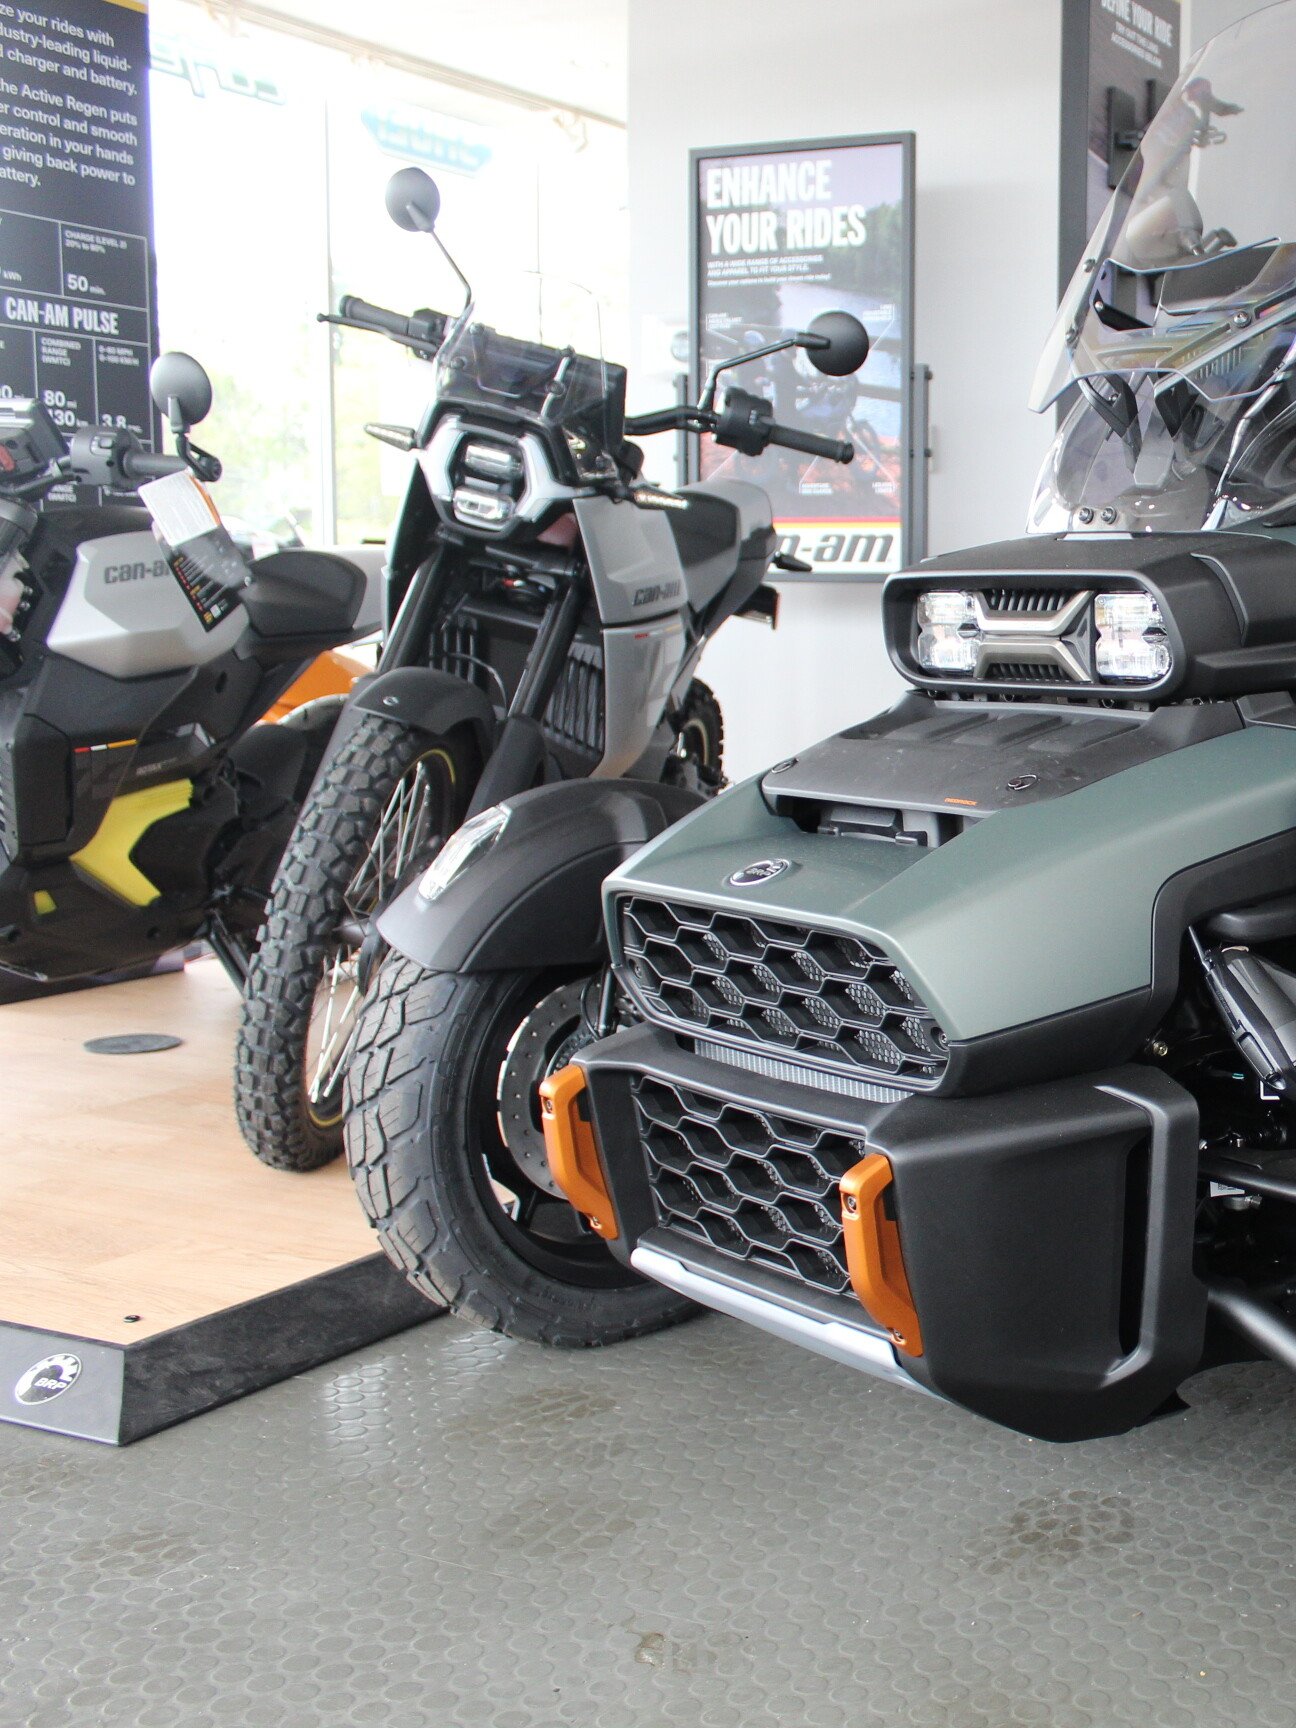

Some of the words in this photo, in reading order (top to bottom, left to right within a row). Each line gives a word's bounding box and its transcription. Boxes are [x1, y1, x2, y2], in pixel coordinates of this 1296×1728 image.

[17, 9, 48, 27] your
[51, 18, 85, 38] rides
[86, 29, 115, 47] with
[7, 48, 60, 72] charger
[63, 64, 88, 81] and
[90, 69, 138, 96] battery.
[93, 50, 132, 71] liquid-
[21, 84, 64, 107] Active
[66, 95, 107, 118] Regen
[110, 109, 138, 126] puts
[12, 106, 61, 128] control
[63, 118, 88, 134] and
[90, 125, 138, 146] smooth
[2, 145, 43, 168] giving
[46, 153, 78, 174] back
[80, 163, 121, 182] power
[122, 172, 136, 186] to
[49, 133, 62, 149] in
[64, 139, 93, 156] your
[95, 144, 134, 165] hands
[706, 159, 832, 209] ENHANCE
[705, 210, 778, 255] YOUR
[786, 203, 867, 250] RIDES
[3, 270, 22, 282] kWh
[67, 273, 89, 293] 50
[5, 297, 69, 328] CAN-AM
[72, 307, 120, 335] PULSE
[44, 390, 66, 408] 80
[33, 1375, 67, 1391] BRP
